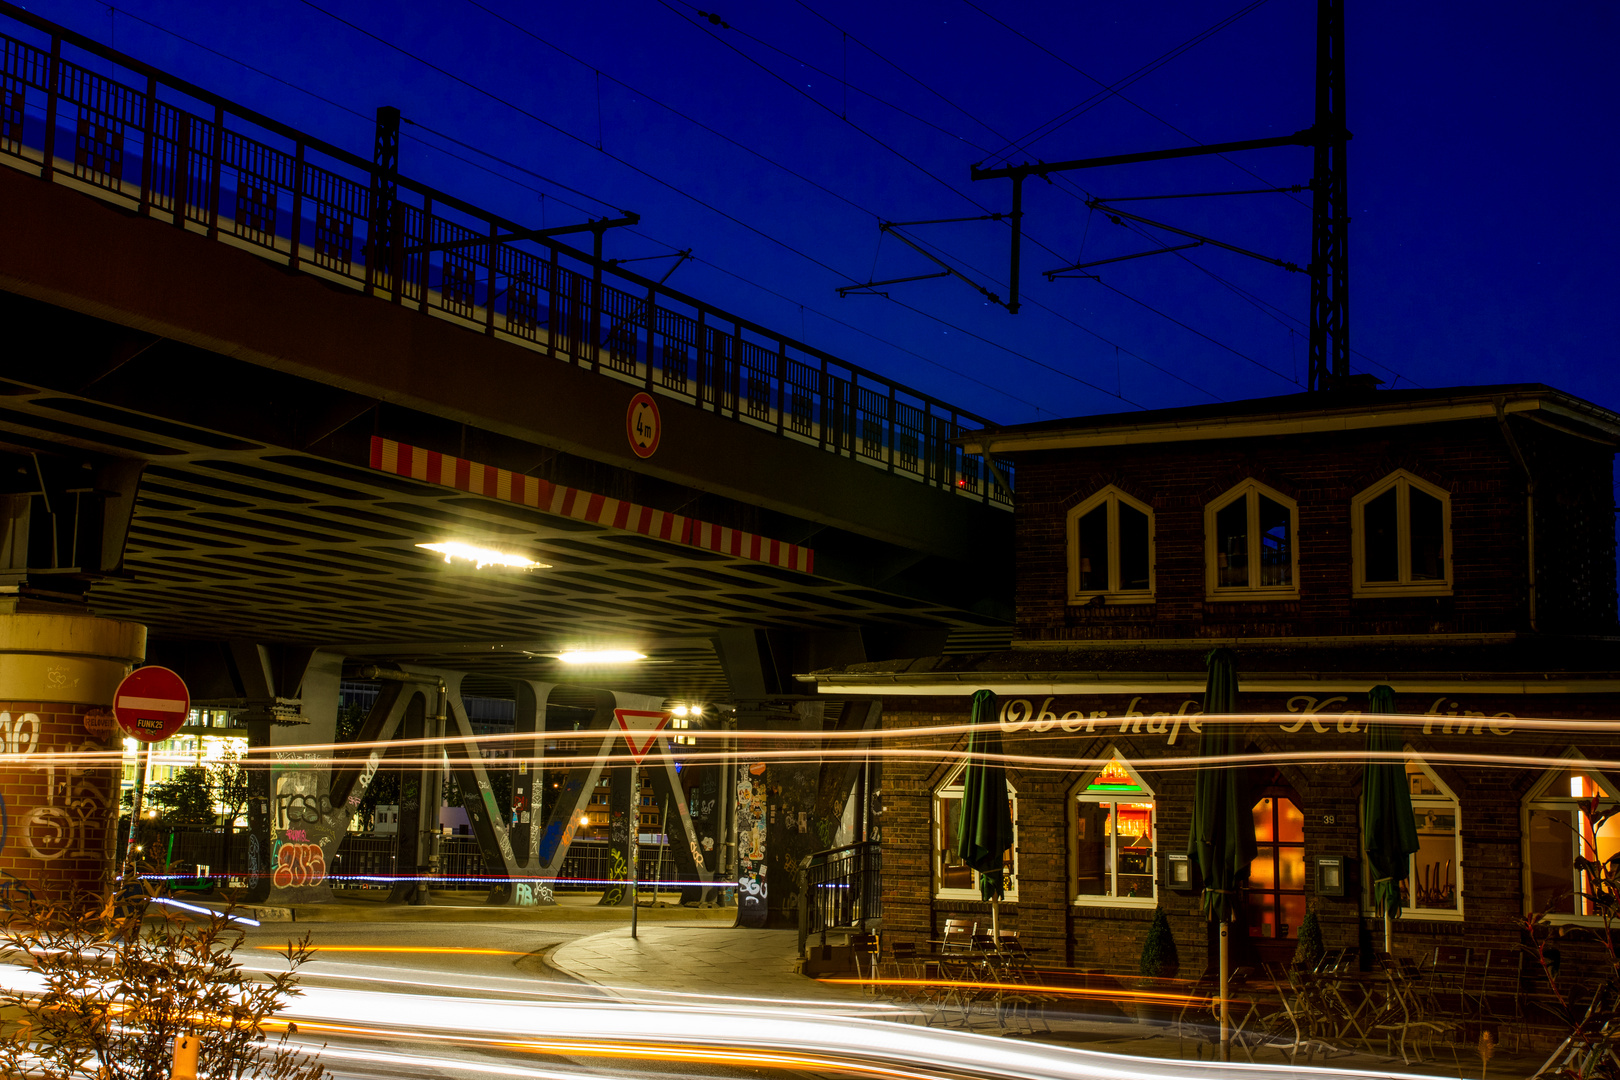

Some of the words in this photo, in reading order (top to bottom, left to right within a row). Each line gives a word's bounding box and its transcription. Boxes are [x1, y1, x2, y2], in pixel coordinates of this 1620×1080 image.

[1000, 697, 1109, 733] Ober
[1279, 695, 1518, 736] Katine
[1323, 815, 1335, 824] 39
